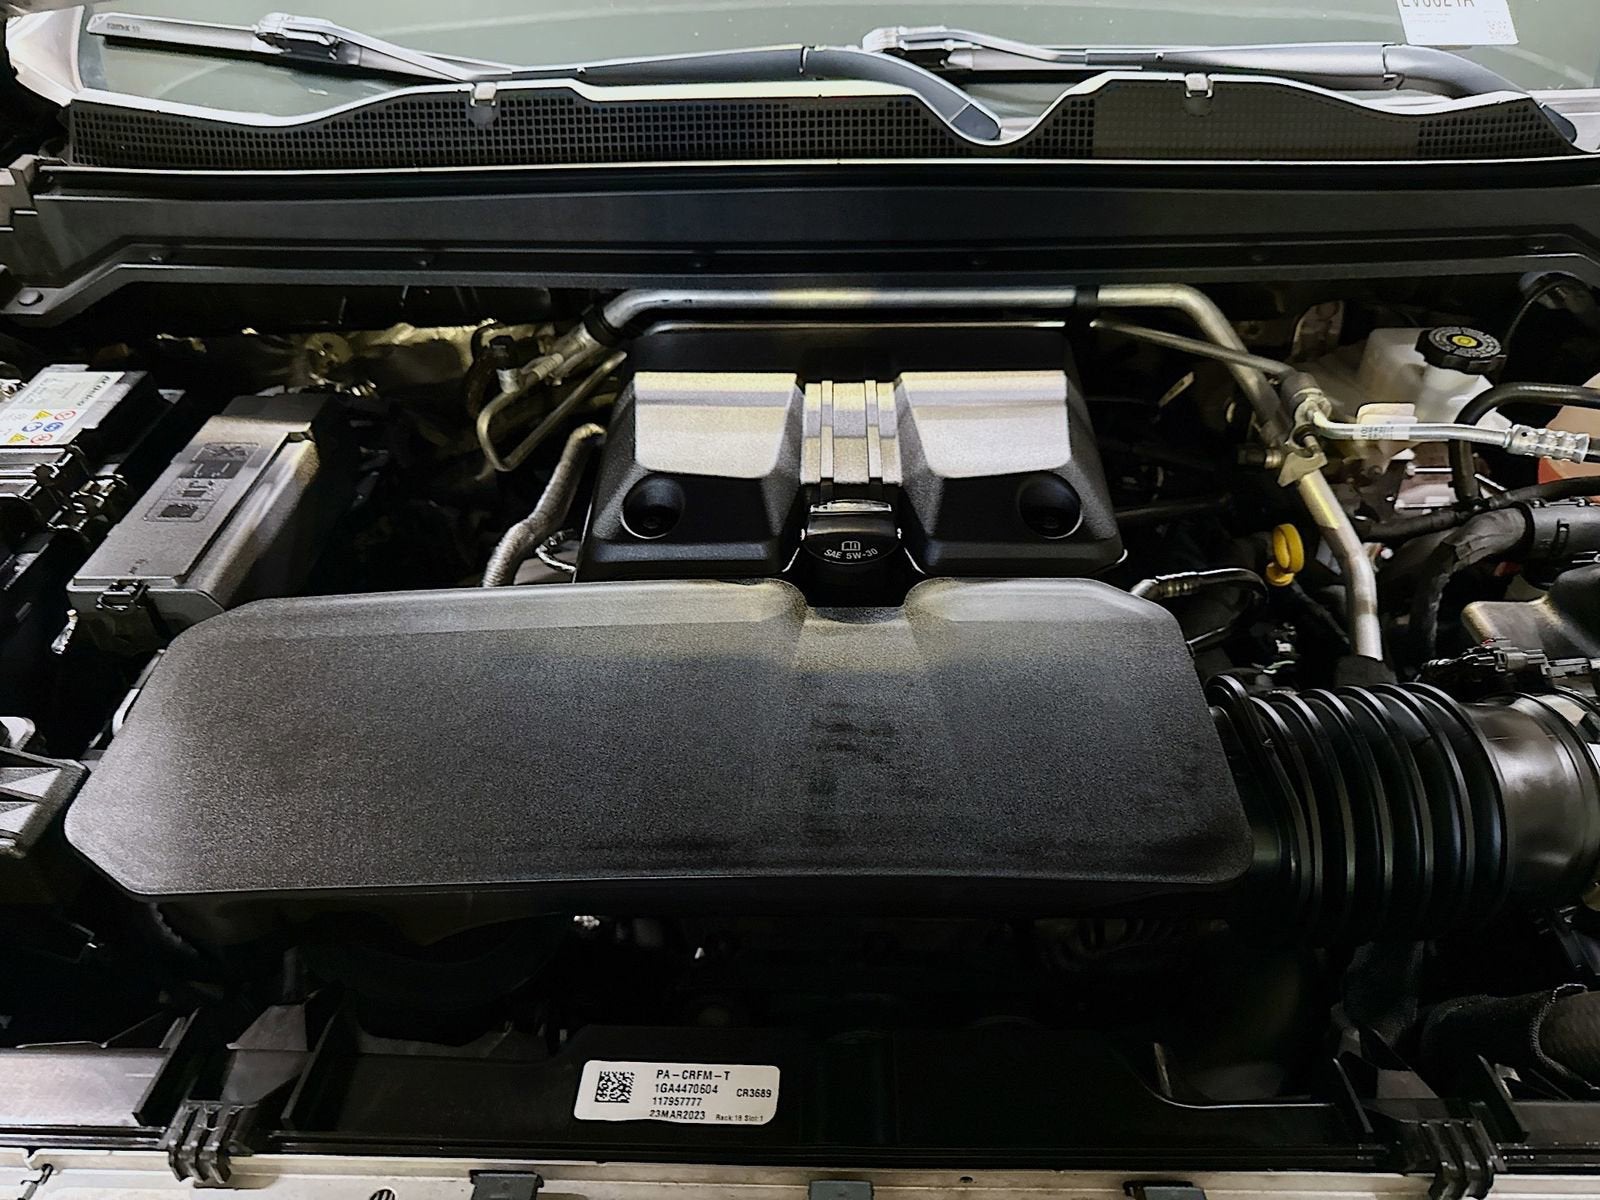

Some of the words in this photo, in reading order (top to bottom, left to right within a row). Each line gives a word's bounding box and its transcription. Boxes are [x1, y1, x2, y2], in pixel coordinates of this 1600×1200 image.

[824, 549, 842, 559] SAE
[846, 548, 878, 560] 5W-30
[655, 1083, 719, 1094] 1GA4470604
[736, 1088, 772, 1098] CR3689
[652, 1096, 703, 1106] 117957777
[649, 1109, 706, 1120] 23MAR2023
